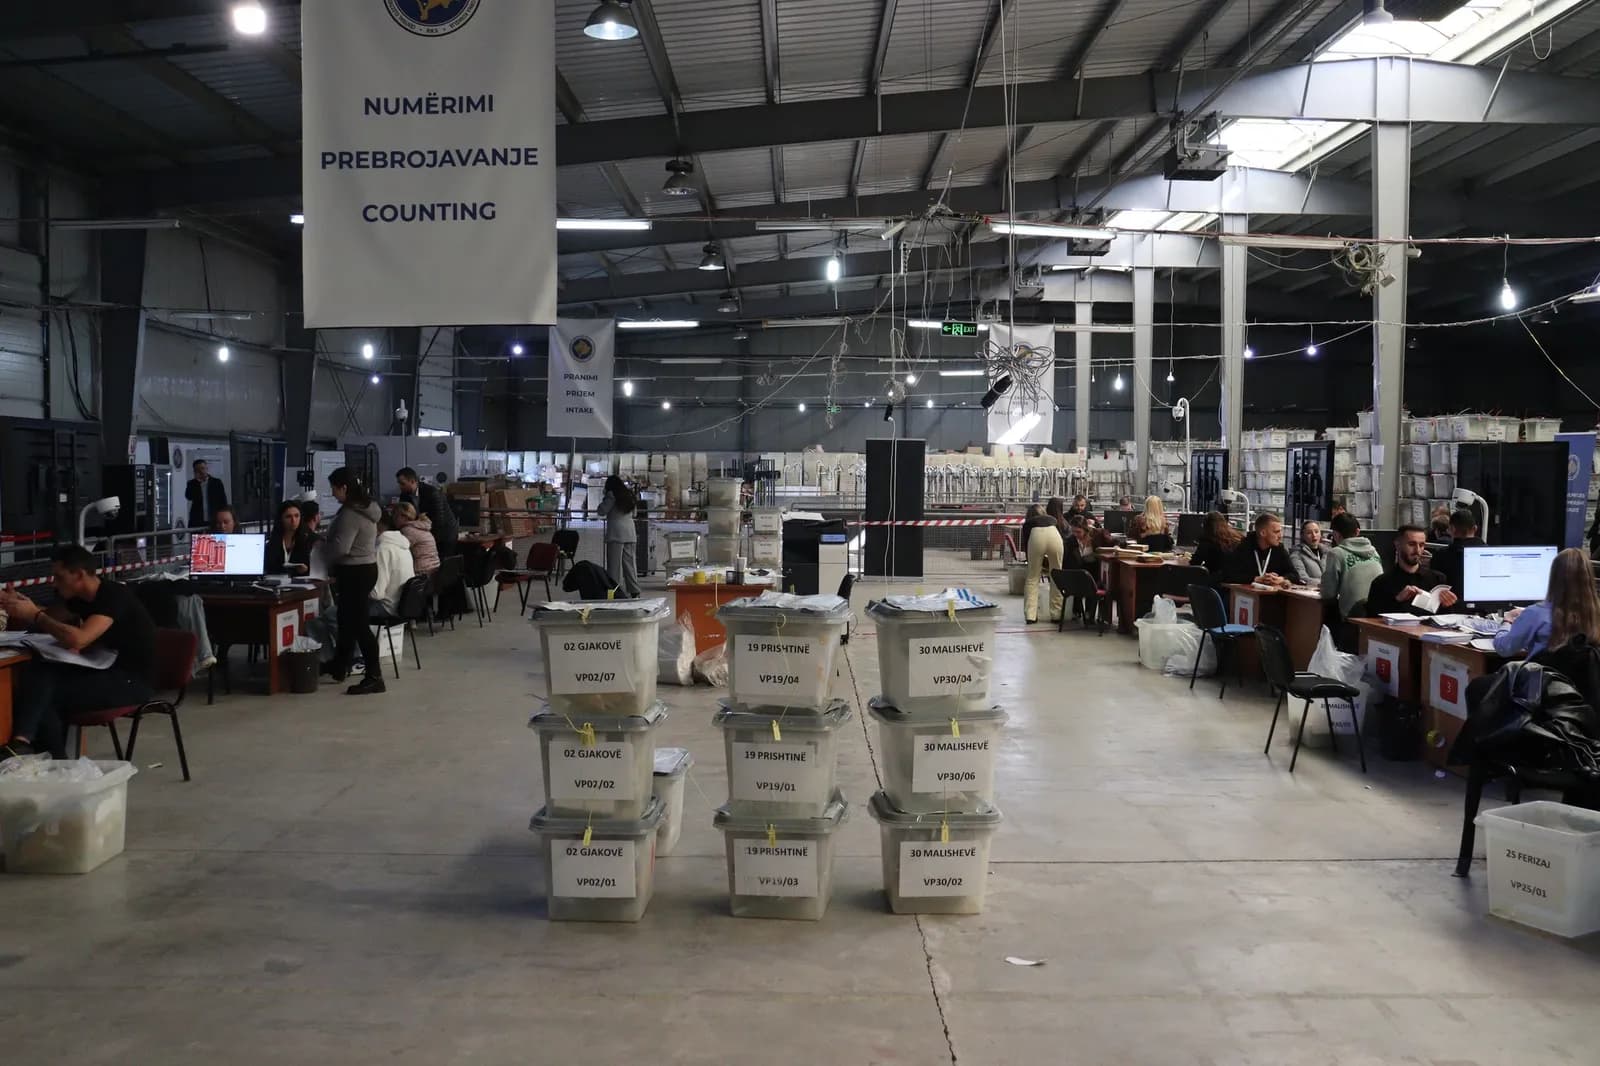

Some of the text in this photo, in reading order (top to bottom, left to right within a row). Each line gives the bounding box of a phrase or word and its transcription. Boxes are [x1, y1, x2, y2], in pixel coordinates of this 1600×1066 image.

[363, 92, 494, 116] NUMËRIMI
[321, 147, 539, 170] PREBROJAVANJE
[361, 202, 496, 223] COUNTING
[563, 373, 598, 381] PRANIMI
[563, 640, 622, 651] 02 GJAKOVË
[747, 643, 759, 652] 19
[919, 642, 984, 655] 30 MALISHEVË
[575, 672, 616, 683] VP02/07
[759, 674, 799, 685] VP19/04
[933, 674, 972, 685] VP30/04
[924, 739, 989, 752] 30 MALISHEVË
[563, 748, 622, 759] 02 GJAKOVË
[744, 751, 806, 762] 19 PRISHTINË
[937, 771, 976, 782] VP30/06
[756, 781, 796, 792] VP19/01
[566, 847, 624, 857] 02 GJAKOVË
[747, 846, 808, 857] 19 PRISHTINË
[910, 846, 976, 858] 30 MALISHEVË
[1505, 848, 1551, 869] 25 FERIZAJ
[576, 878, 617, 888] VP02/01
[759, 876, 799, 887] VP19/03
[923, 878, 963, 888] VP30/02
[1510, 880, 1547, 898] VP25/01
